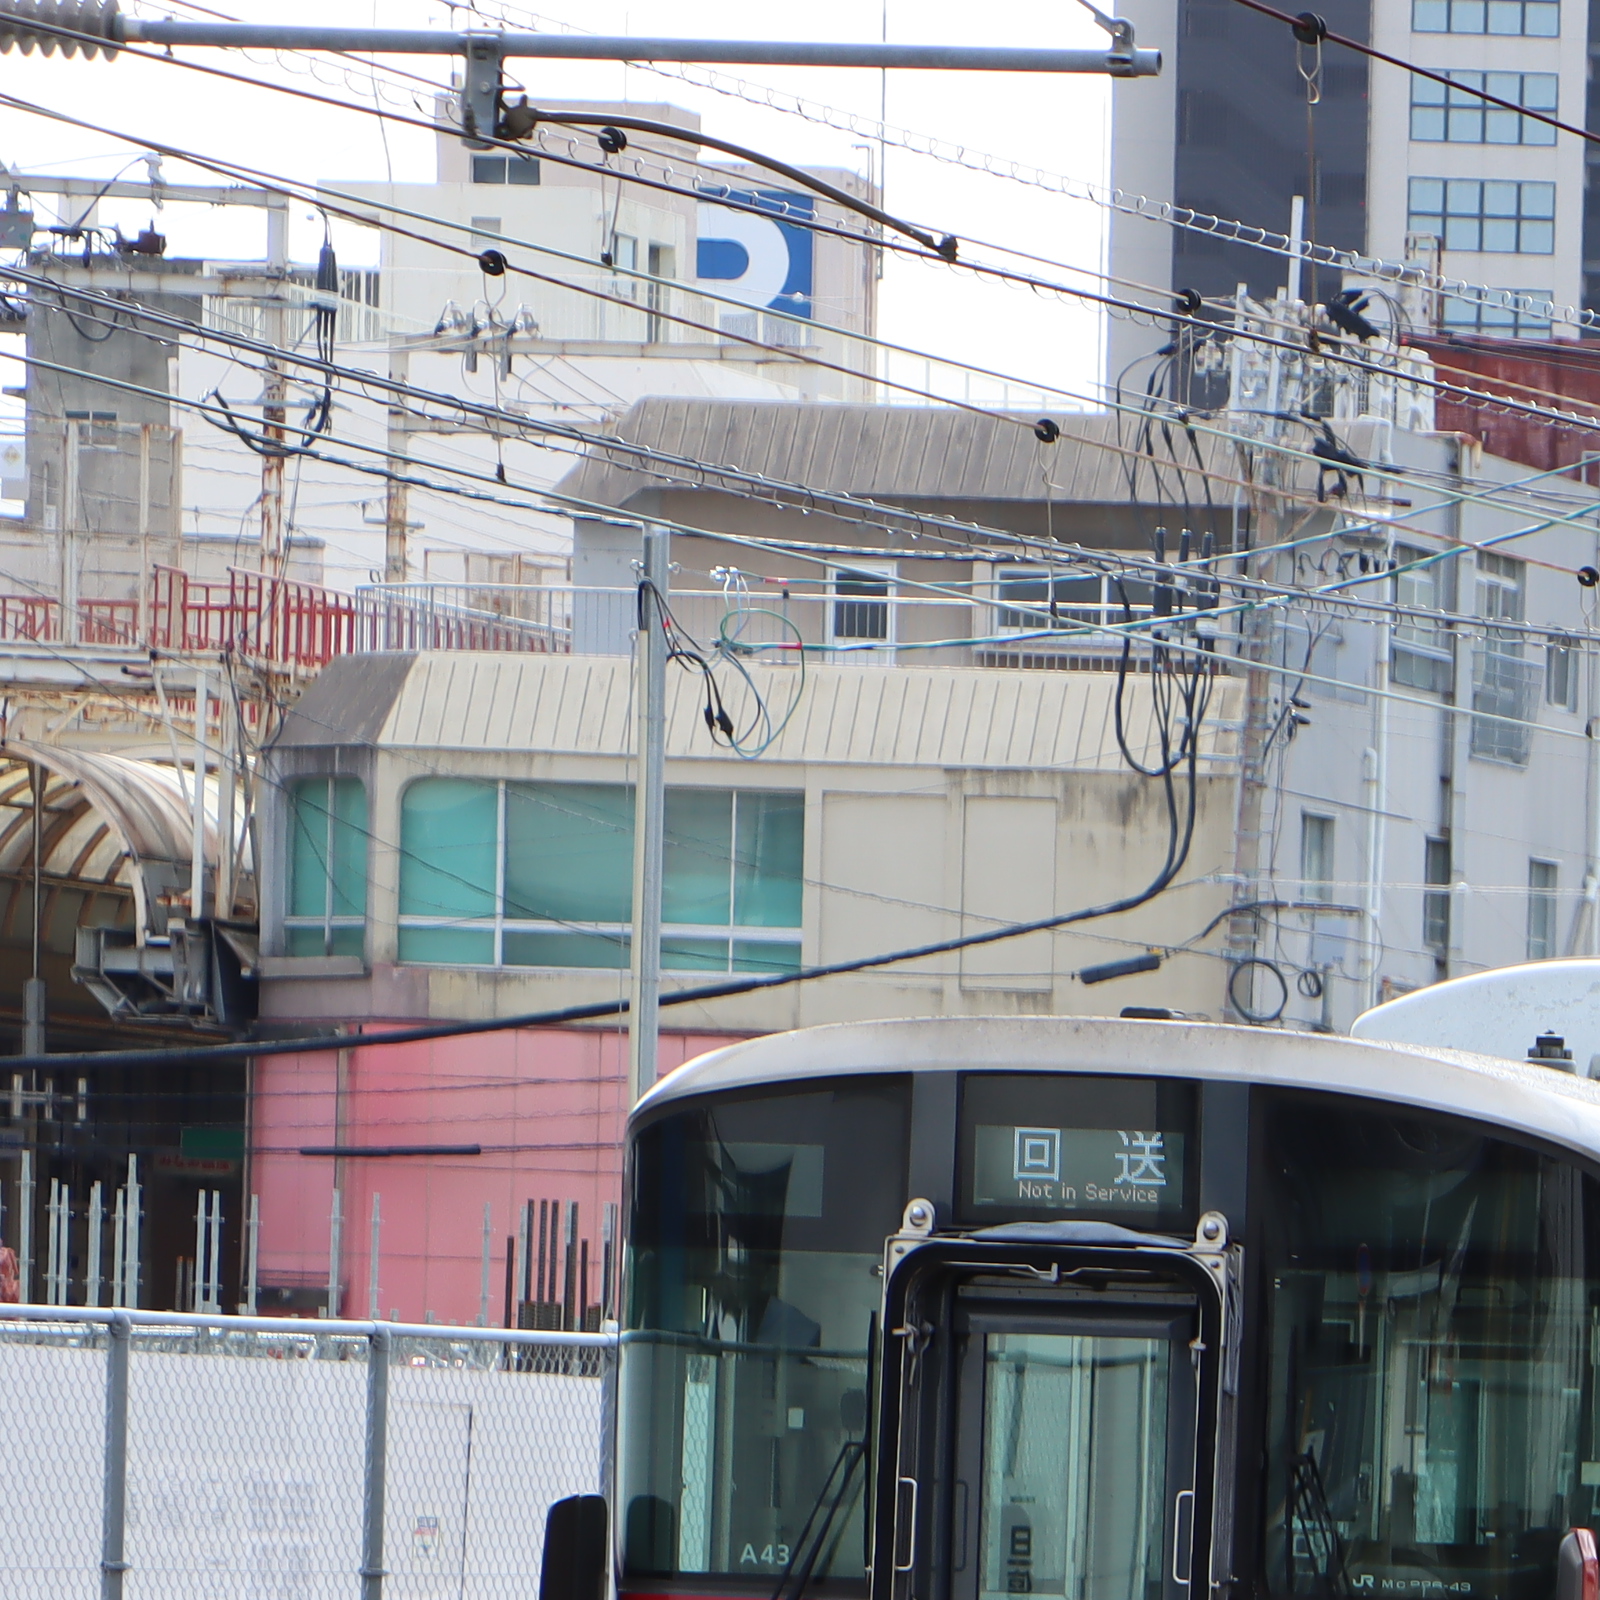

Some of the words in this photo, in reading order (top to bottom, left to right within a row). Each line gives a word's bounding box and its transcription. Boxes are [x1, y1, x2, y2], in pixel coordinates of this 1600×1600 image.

[1013, 1126, 1167, 1186] 回送
[1018, 1180, 1053, 1199] Not
[1061, 1182, 1077, 1200] in
[1085, 1183, 1159, 1203] Service
[739, 1543, 790, 1566] A43
[1352, 1574, 1375, 1589] JR
